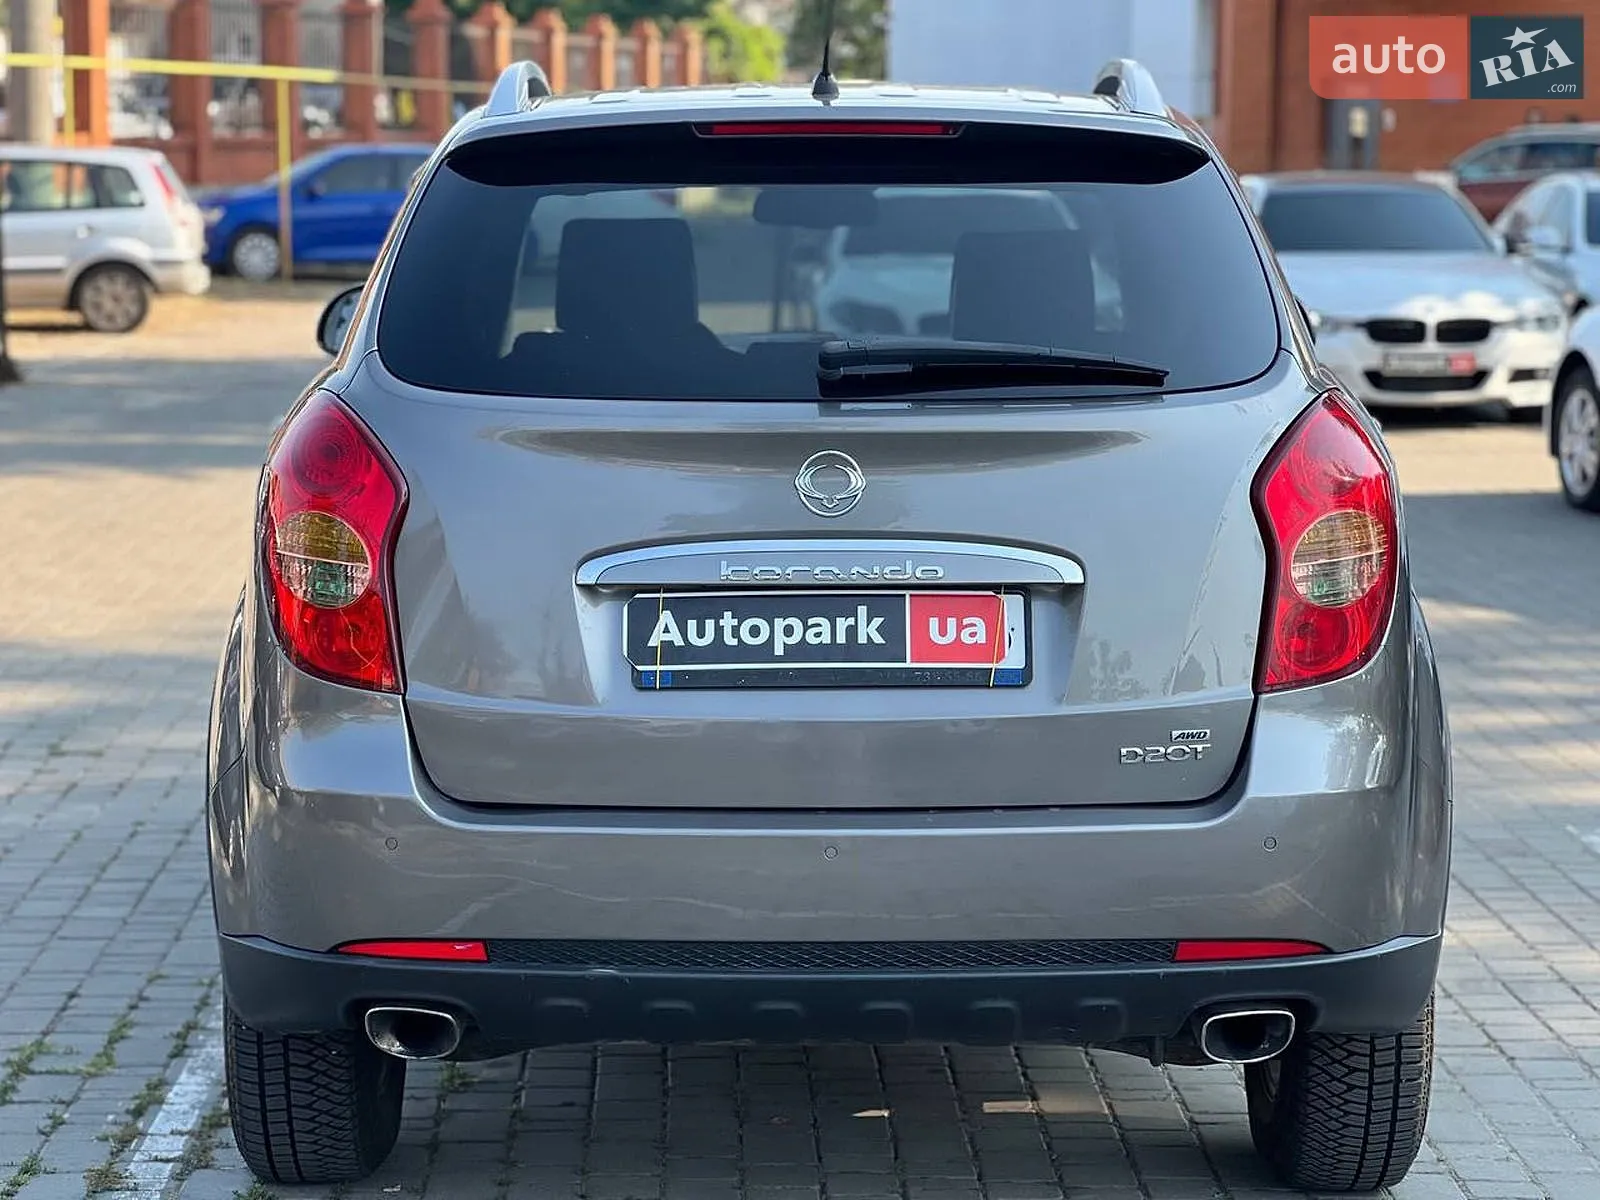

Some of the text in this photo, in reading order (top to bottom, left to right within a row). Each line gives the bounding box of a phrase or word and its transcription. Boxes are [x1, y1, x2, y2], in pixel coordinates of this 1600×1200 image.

[647, 605, 886, 656] Autopark
[928, 616, 987, 645] ua
[1174, 731, 1207, 740] AWD
